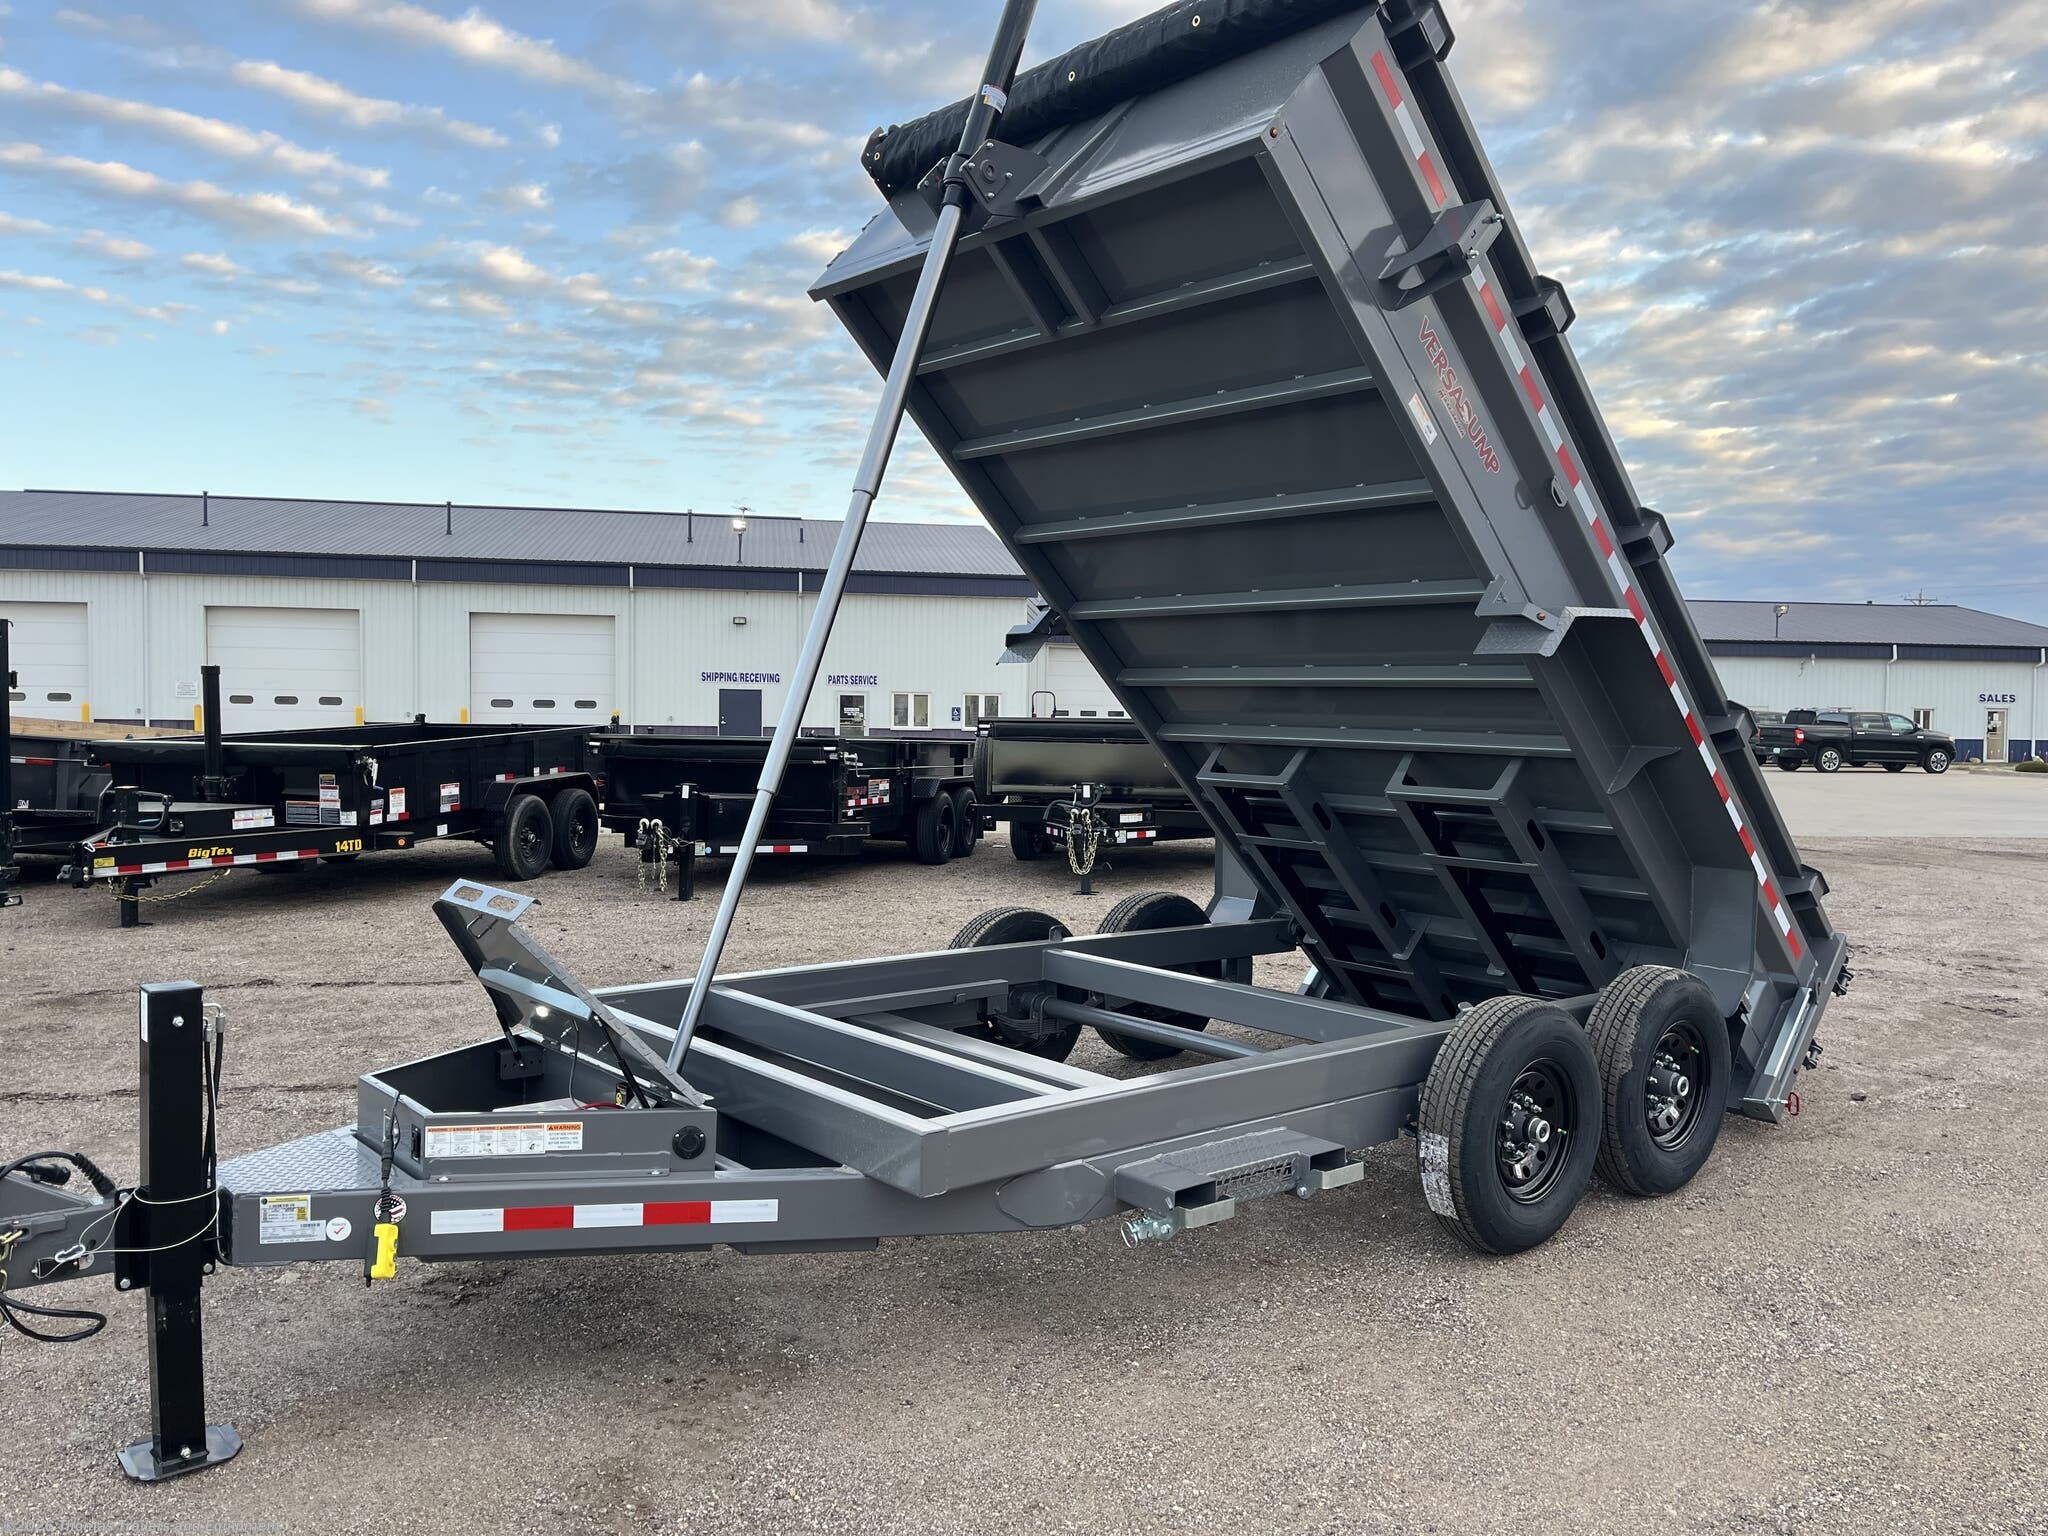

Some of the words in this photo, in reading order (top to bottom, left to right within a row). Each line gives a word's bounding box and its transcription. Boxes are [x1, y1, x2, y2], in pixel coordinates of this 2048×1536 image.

[701, 672, 738, 682] SHIPPING
[740, 672, 780, 683] RECEIVING
[828, 675, 849, 685] PARTS
[850, 675, 878, 685] SERVICE
[1979, 693, 2016, 703] SALES
[335, 839, 362, 853] 14TD
[188, 847, 234, 859] BigTex
